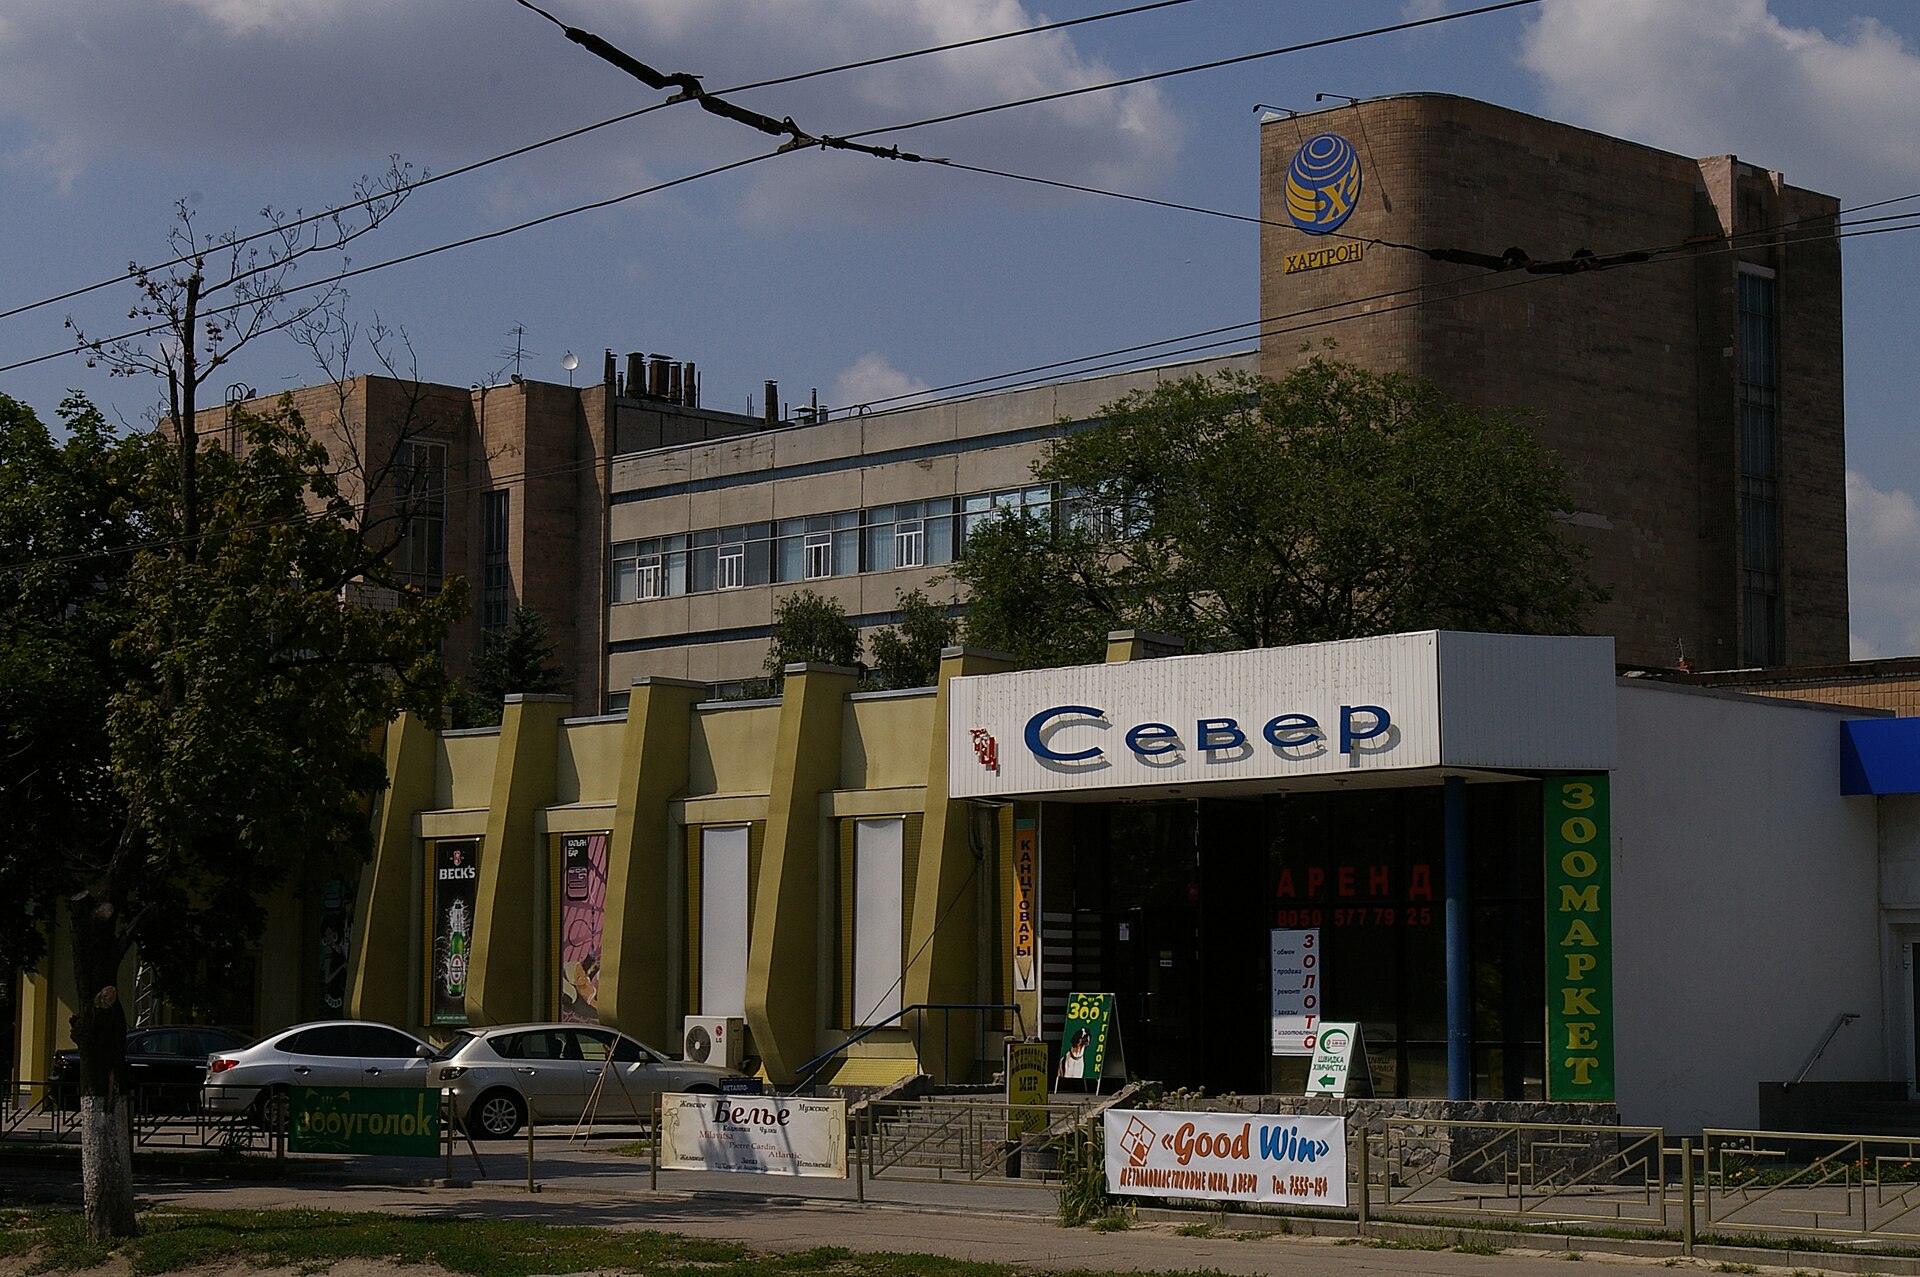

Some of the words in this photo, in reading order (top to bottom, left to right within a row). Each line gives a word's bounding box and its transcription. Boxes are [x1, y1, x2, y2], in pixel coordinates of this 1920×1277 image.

[1286, 243, 1360, 273] ХАРТРОН
[1023, 705, 1391, 761] Север
[439, 865, 476, 880] BECK'S
[1276, 864, 1433, 903] АРЕНД
[1016, 840, 1032, 957] КАНЦТОВАРЫ
[1277, 908, 1322, 927] 8050
[1333, 908, 1367, 928] 577
[1373, 906, 1397, 926] 79
[1406, 906, 1432, 926] 25
[1558, 782, 1601, 1085] ЗООМАРКЕТ
[1277, 987, 1300, 995] ремонт
[1302, 934, 1317, 1049] ЗОЛОТО
[1094, 1011, 1108, 1072] уголок
[679, 1100, 707, 1109] Женское
[712, 1100, 790, 1126] Белье
[798, 1103, 830, 1113] Мужское
[699, 1130, 734, 1140] Milavitsa
[728, 1141, 750, 1150] Pierre
[751, 1142, 776, 1150] Cardin
[1161, 1122, 1251, 1166] «Good
[1260, 1125, 1330, 1163] Win»
[768, 1151, 802, 1160] Atlantic
[1120, 1167, 1206, 1191] МЕТАЛЛОПЛАСТИКОВЫЕ
[1208, 1171, 1229, 1195] ОКНА,
[1231, 1173, 1258, 1193] ДВЕРИ
[1272, 1174, 1287, 1195] Тел.
[1289, 1175, 1328, 1197] 7555-154
